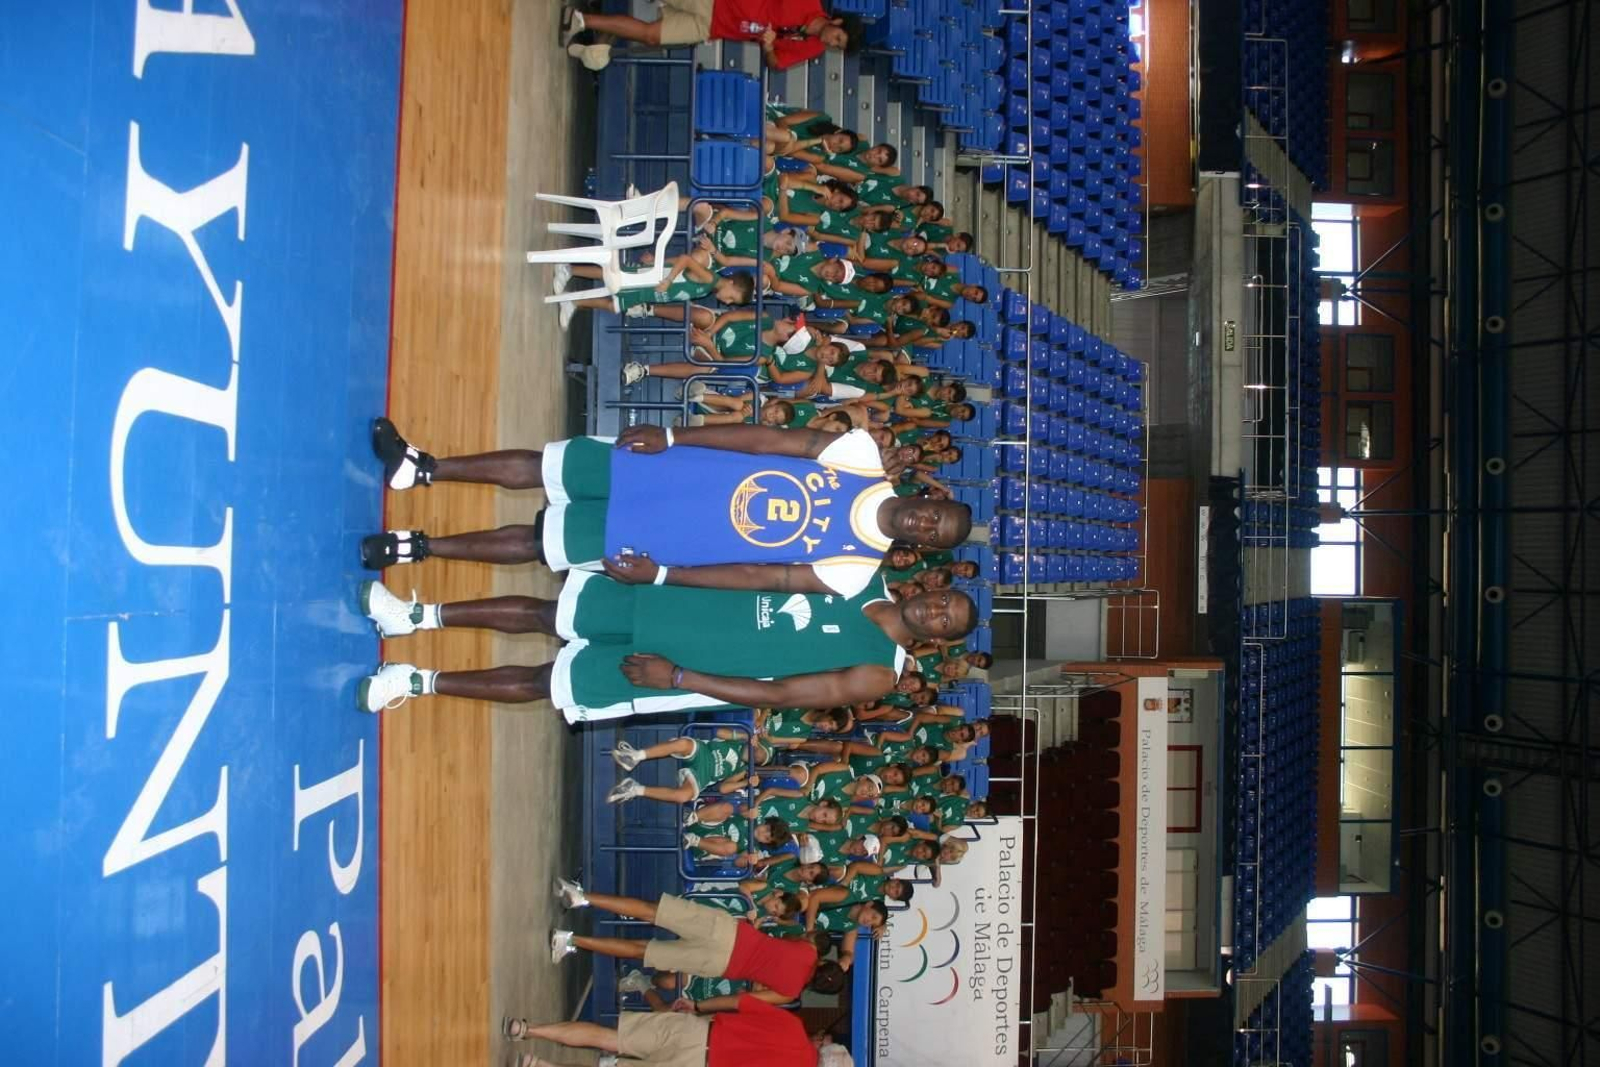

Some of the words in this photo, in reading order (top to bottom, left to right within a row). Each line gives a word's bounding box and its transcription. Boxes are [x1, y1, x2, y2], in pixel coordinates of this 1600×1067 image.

[823, 467, 840, 490] The
[767, 499, 800, 522] 2
[802, 472, 831, 554] CITY
[758, 596, 775, 628] Unicaja
[1141, 729, 1151, 780] Palacio
[1141, 784, 1150, 802] de
[1139, 807, 1150, 872] Deportes
[998, 836, 1016, 915] Palacio
[1140, 877, 1149, 895] de
[974, 888, 992, 913] de
[997, 922, 1014, 948] de
[968, 922, 991, 1002] Málaga
[876, 986, 894, 1058] Carpena
[991, 957, 1013, 1056] Deportes
